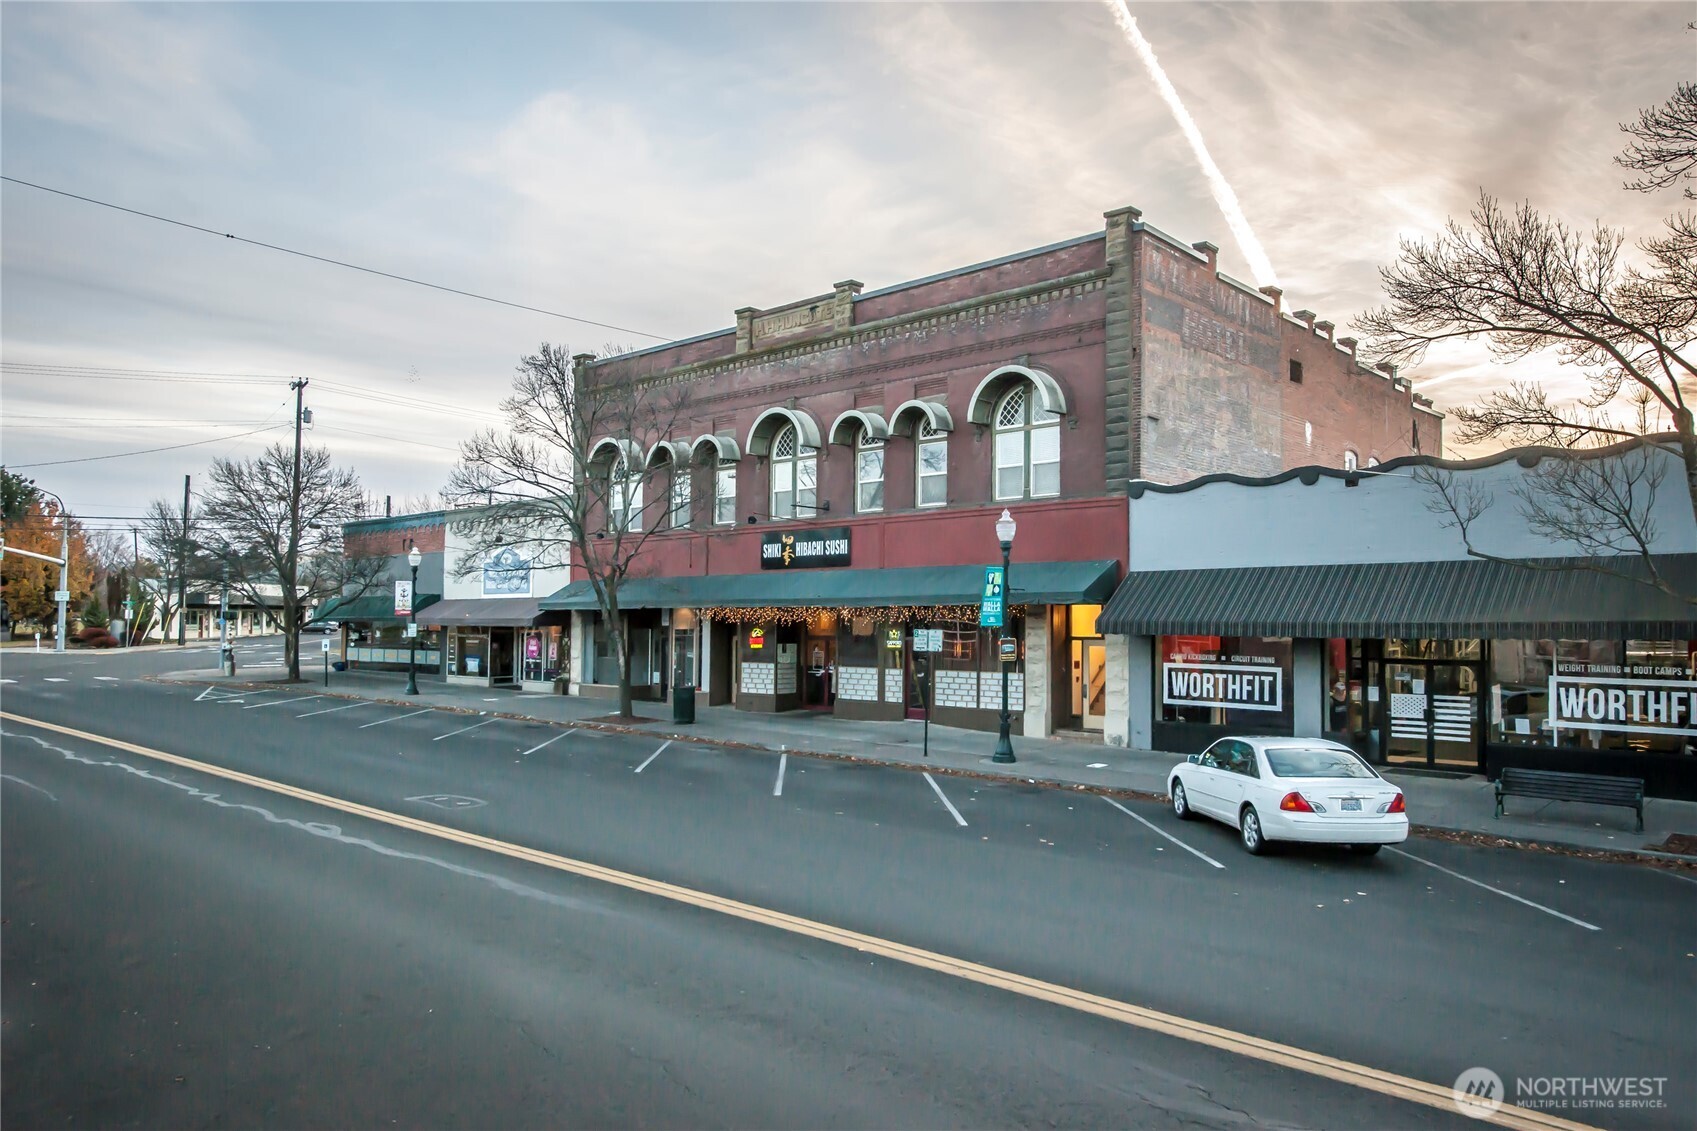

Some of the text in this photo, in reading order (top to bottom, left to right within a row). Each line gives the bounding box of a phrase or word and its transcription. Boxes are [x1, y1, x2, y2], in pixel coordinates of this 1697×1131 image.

[763, 539, 848, 559] SHIKI HIBACHI SUSHI
[1231, 655, 1275, 664] CIRCUIT TRAINING
[1558, 664, 1621, 674] WEIGHT TRAINING
[1633, 665, 1683, 676] BOOT CAMPS
[1171, 671, 1274, 702] WORTHFIT
